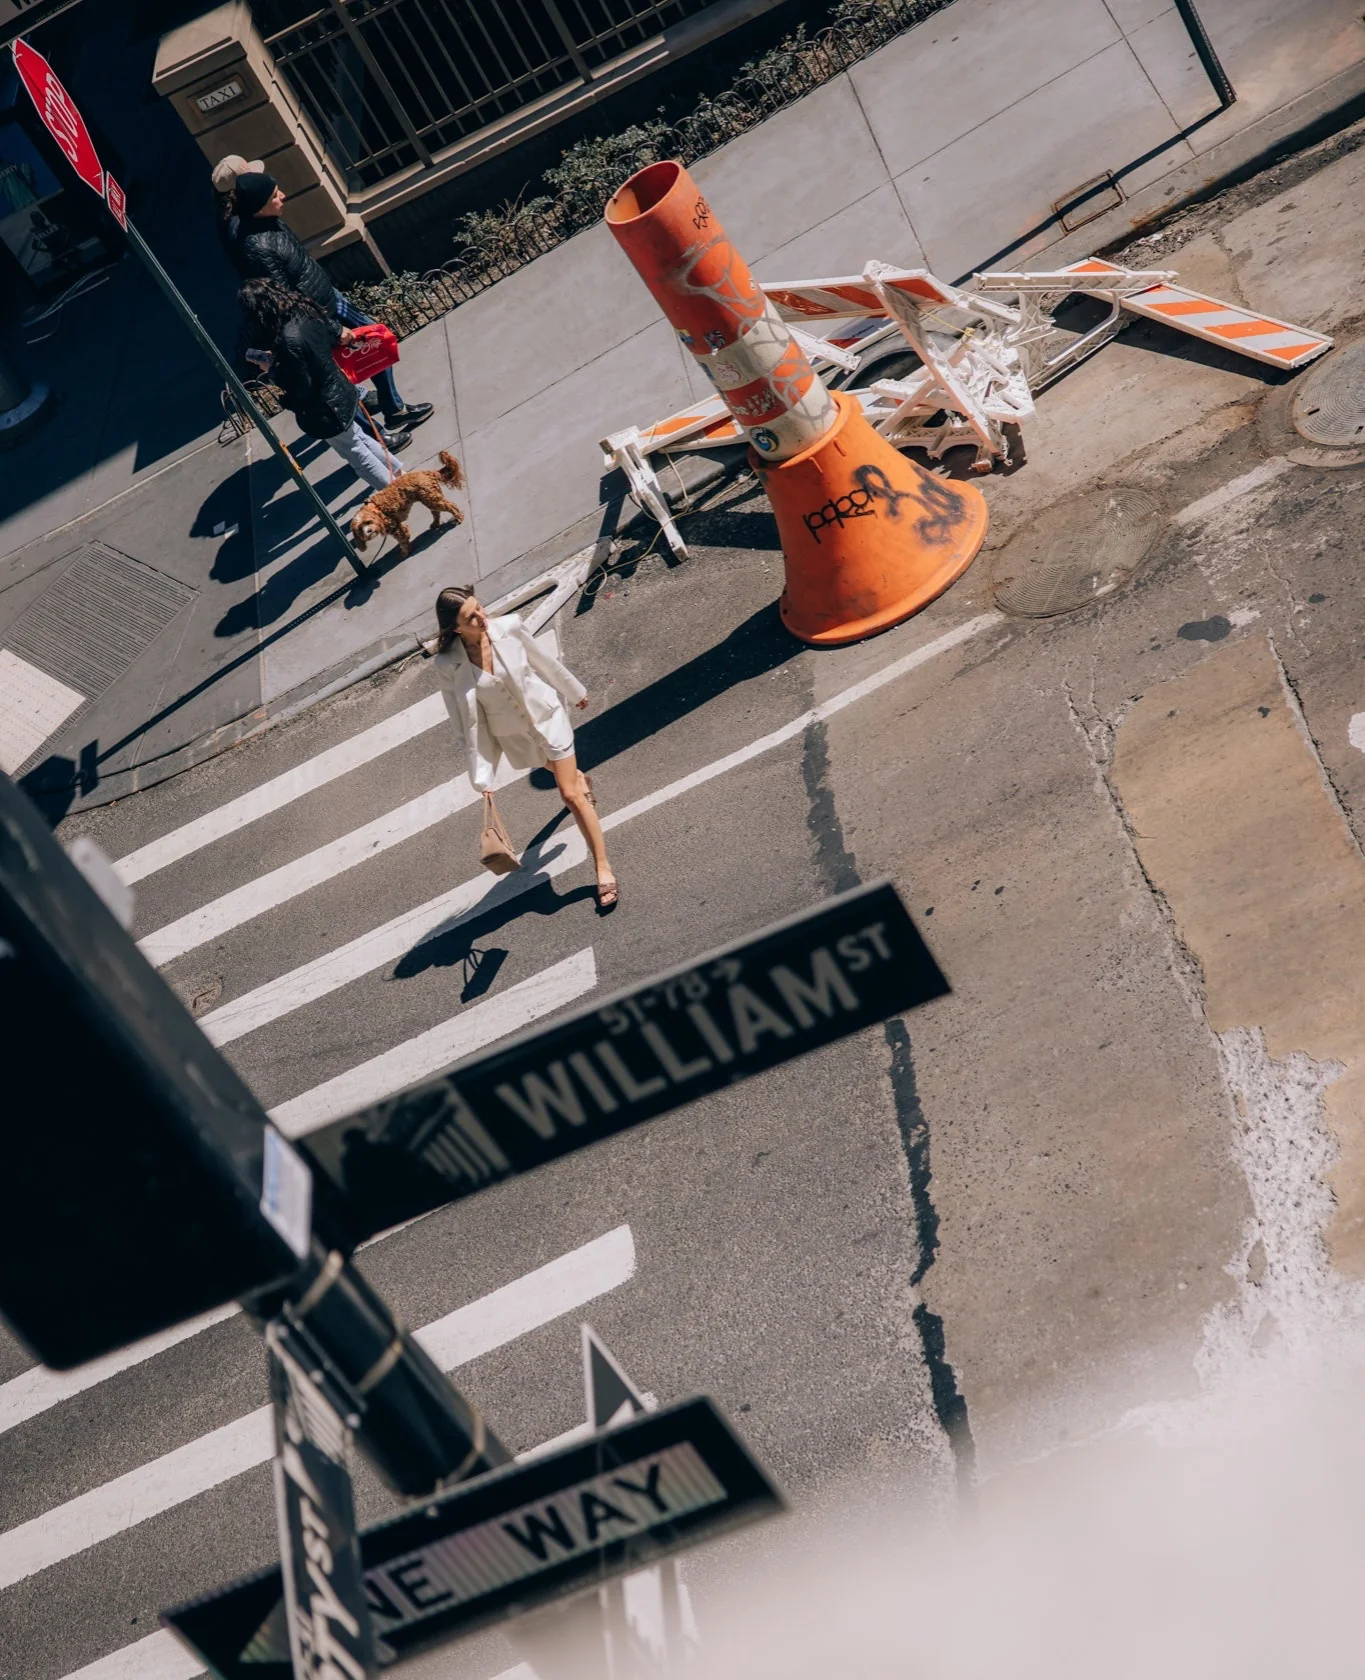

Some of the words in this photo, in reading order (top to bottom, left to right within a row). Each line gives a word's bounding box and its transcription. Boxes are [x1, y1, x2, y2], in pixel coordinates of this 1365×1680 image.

[44, 71, 79, 163] STOP
[200, 85, 237, 110] TAXI
[495, 946, 861, 1139] WILLIAM
[837, 923, 894, 973] ST
[298, 1495, 334, 1575] ST
[362, 1556, 455, 1622] NE
[502, 1463, 672, 1563] WAY
[303, 1559, 366, 1680] TY
